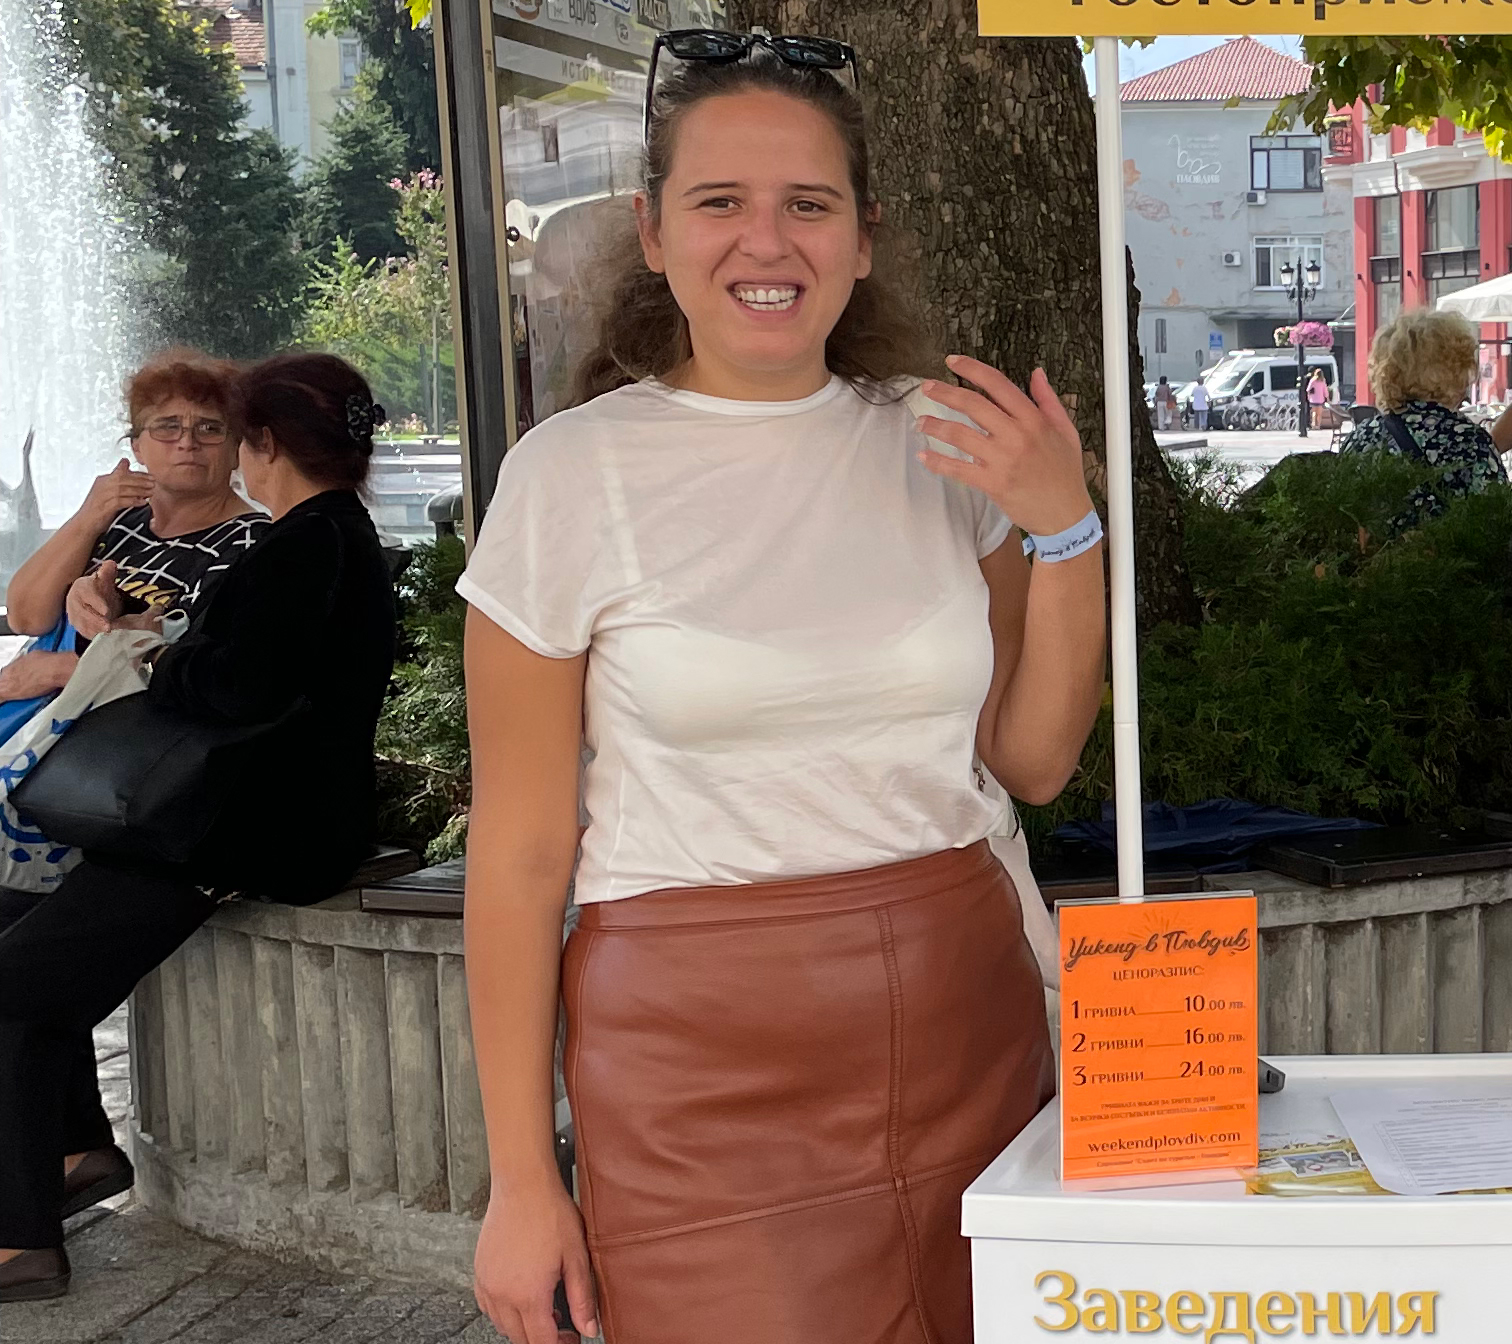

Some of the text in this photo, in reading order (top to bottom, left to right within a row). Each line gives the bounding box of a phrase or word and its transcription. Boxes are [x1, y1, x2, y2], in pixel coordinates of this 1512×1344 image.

[1065, 927, 1249, 970] Уикенд в Пловдив
[1112, 964, 1205, 981] ЦЕНОРАЗПИС
[1070, 999, 1080, 1019] 1
[1084, 1006, 1137, 1019] ГРИВНА
[1184, 994, 1226, 1013] 10.00
[1071, 1032, 1087, 1053] 2
[1090, 1038, 1144, 1052] ГРИВНИ
[1183, 1027, 1225, 1045] 16.00
[1072, 1065, 1087, 1086] 3
[1091, 1071, 1145, 1085] ГРИВНИ
[1179, 1060, 1226, 1079] 24.00
[1087, 1131, 1242, 1153] weekendplovdiv.com
